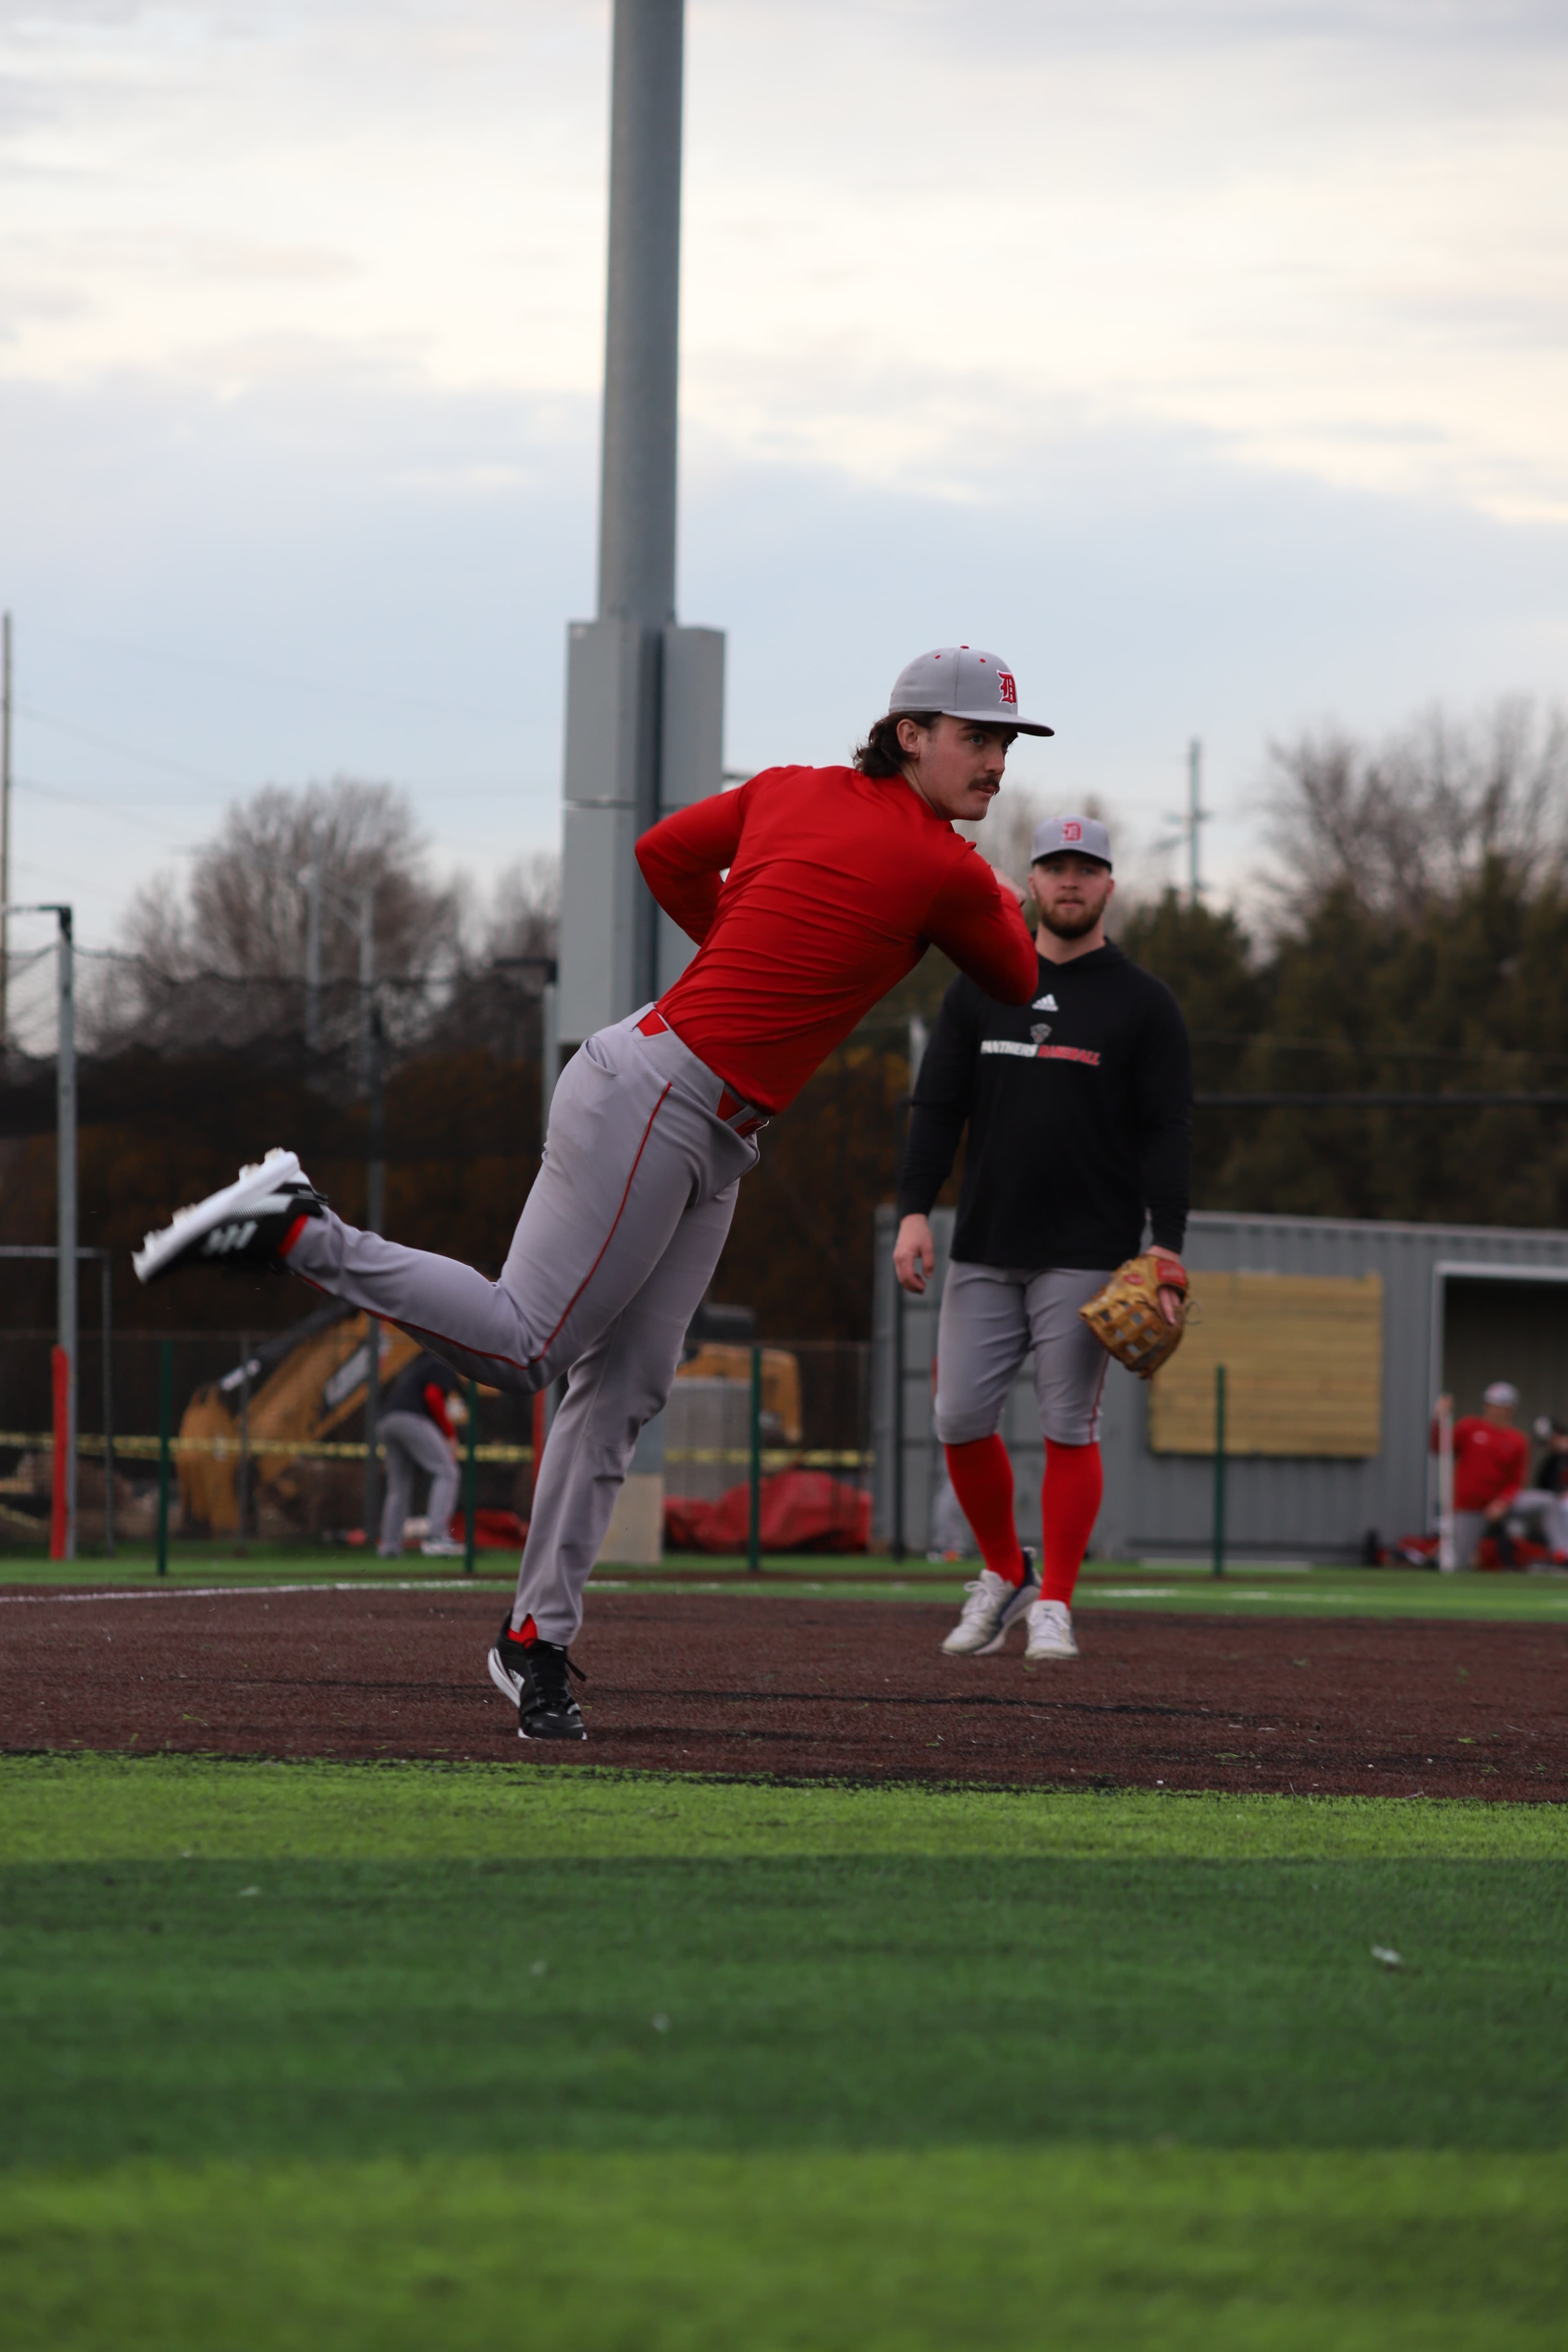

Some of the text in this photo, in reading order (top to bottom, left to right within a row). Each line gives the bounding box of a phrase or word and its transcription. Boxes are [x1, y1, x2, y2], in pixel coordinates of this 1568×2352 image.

[996, 670, 1016, 705] D
[980, 1040, 1100, 1066] PANTHERS BASEBALL
